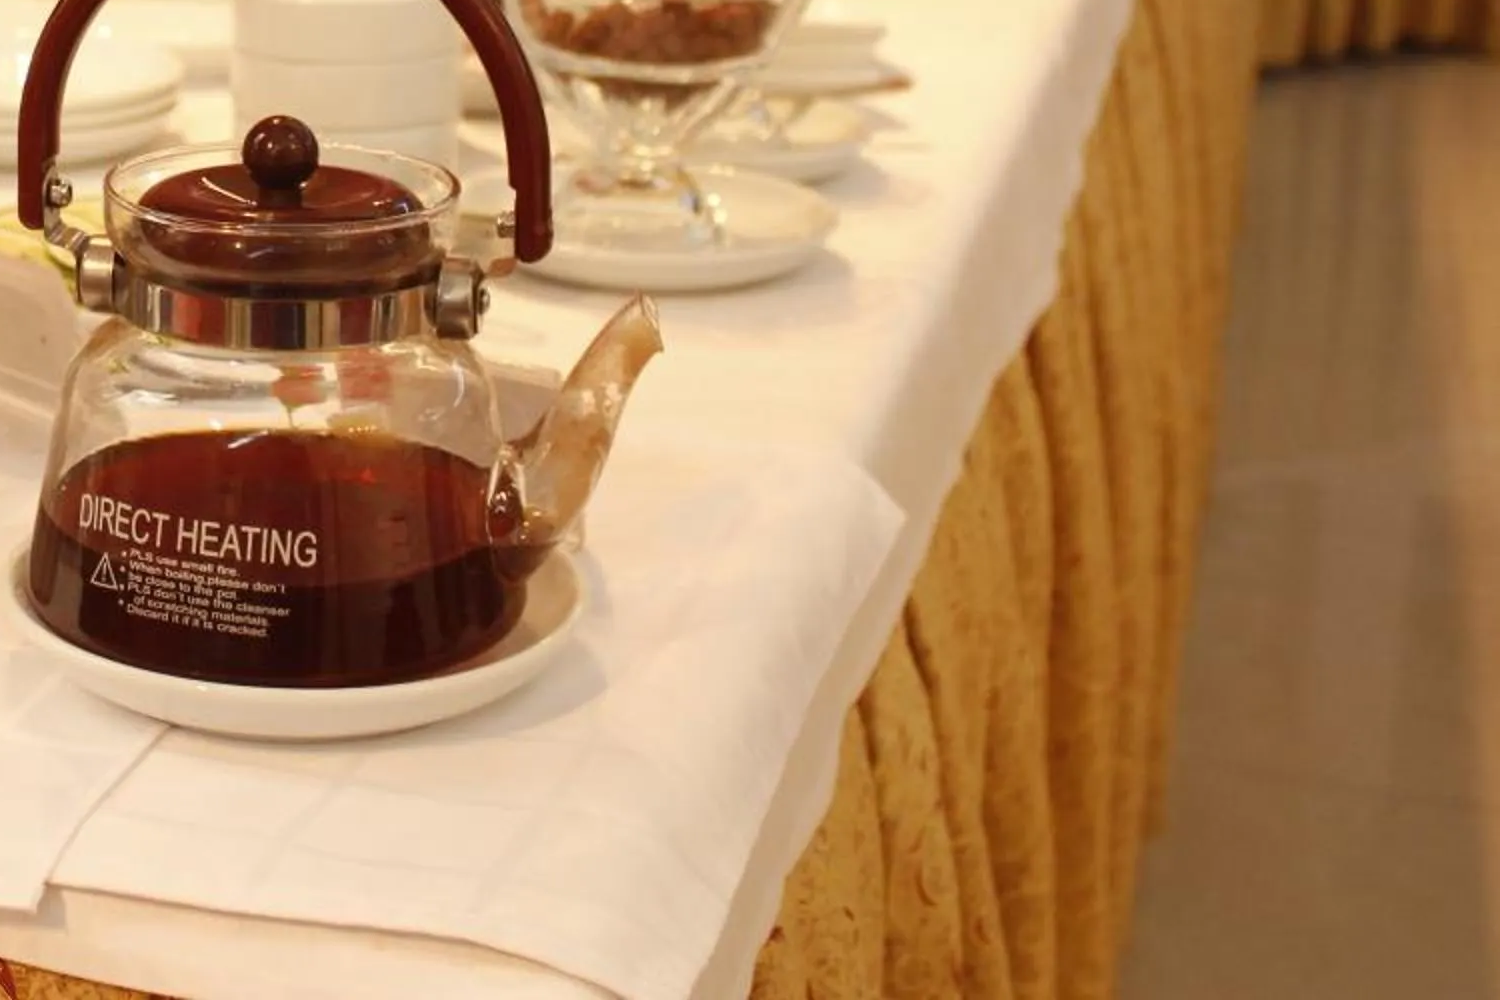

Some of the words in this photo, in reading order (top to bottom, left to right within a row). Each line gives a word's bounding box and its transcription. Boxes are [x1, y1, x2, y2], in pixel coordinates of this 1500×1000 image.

[79, 493, 170, 548] DIRECT
[176, 517, 318, 568] HEATING
[129, 548, 153, 563] PLS
[156, 556, 178, 566] use
[181, 561, 214, 573] small
[129, 560, 162, 574] When
[128, 572, 143, 583] be
[145, 577, 176, 589] close
[179, 582, 191, 593] to
[193, 584, 213, 597] the
[127, 582, 150, 595] PLS
[187, 595, 210, 606] use
[213, 599, 233, 610] the
[236, 602, 290, 617] cleanser
[147, 599, 209, 621] scratching
[127, 603, 169, 621] Discard
[171, 614, 179, 624] it
[192, 618, 200, 628] it
[203, 621, 213, 630] is
